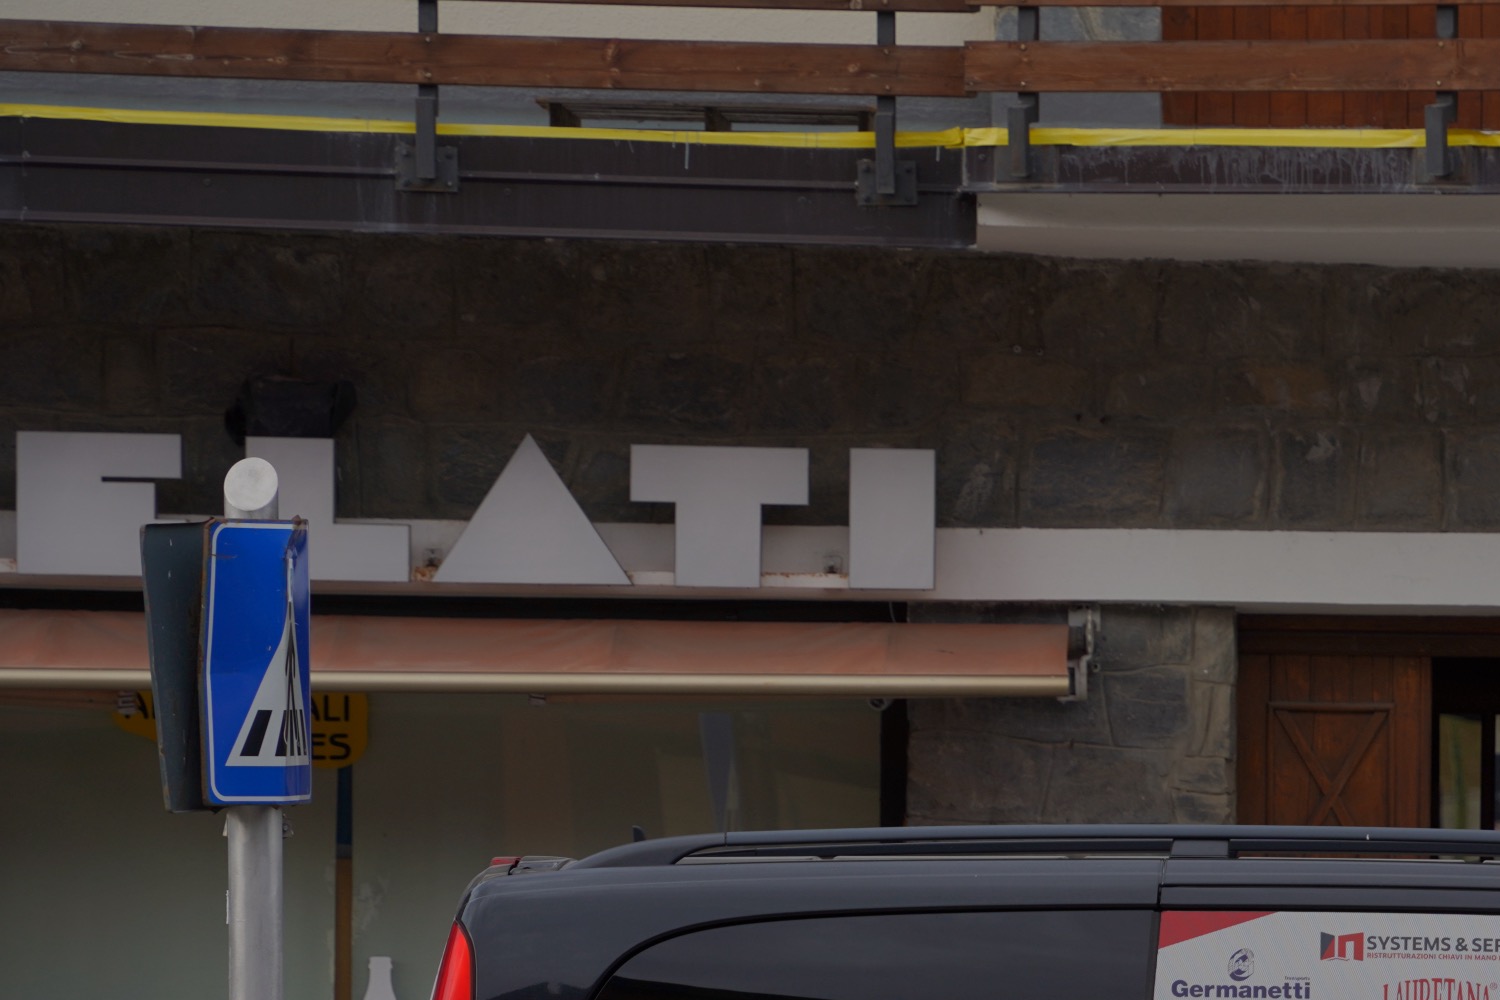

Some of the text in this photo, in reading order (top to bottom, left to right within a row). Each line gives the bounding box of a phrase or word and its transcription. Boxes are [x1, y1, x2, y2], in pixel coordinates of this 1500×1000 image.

[1367, 935, 1451, 951] SYSTEMS
[1455, 937, 1468, 951] &
[1366, 952, 1436, 960] RISTRUTTURAZIONI
[1171, 979, 1311, 999] Germanetti
